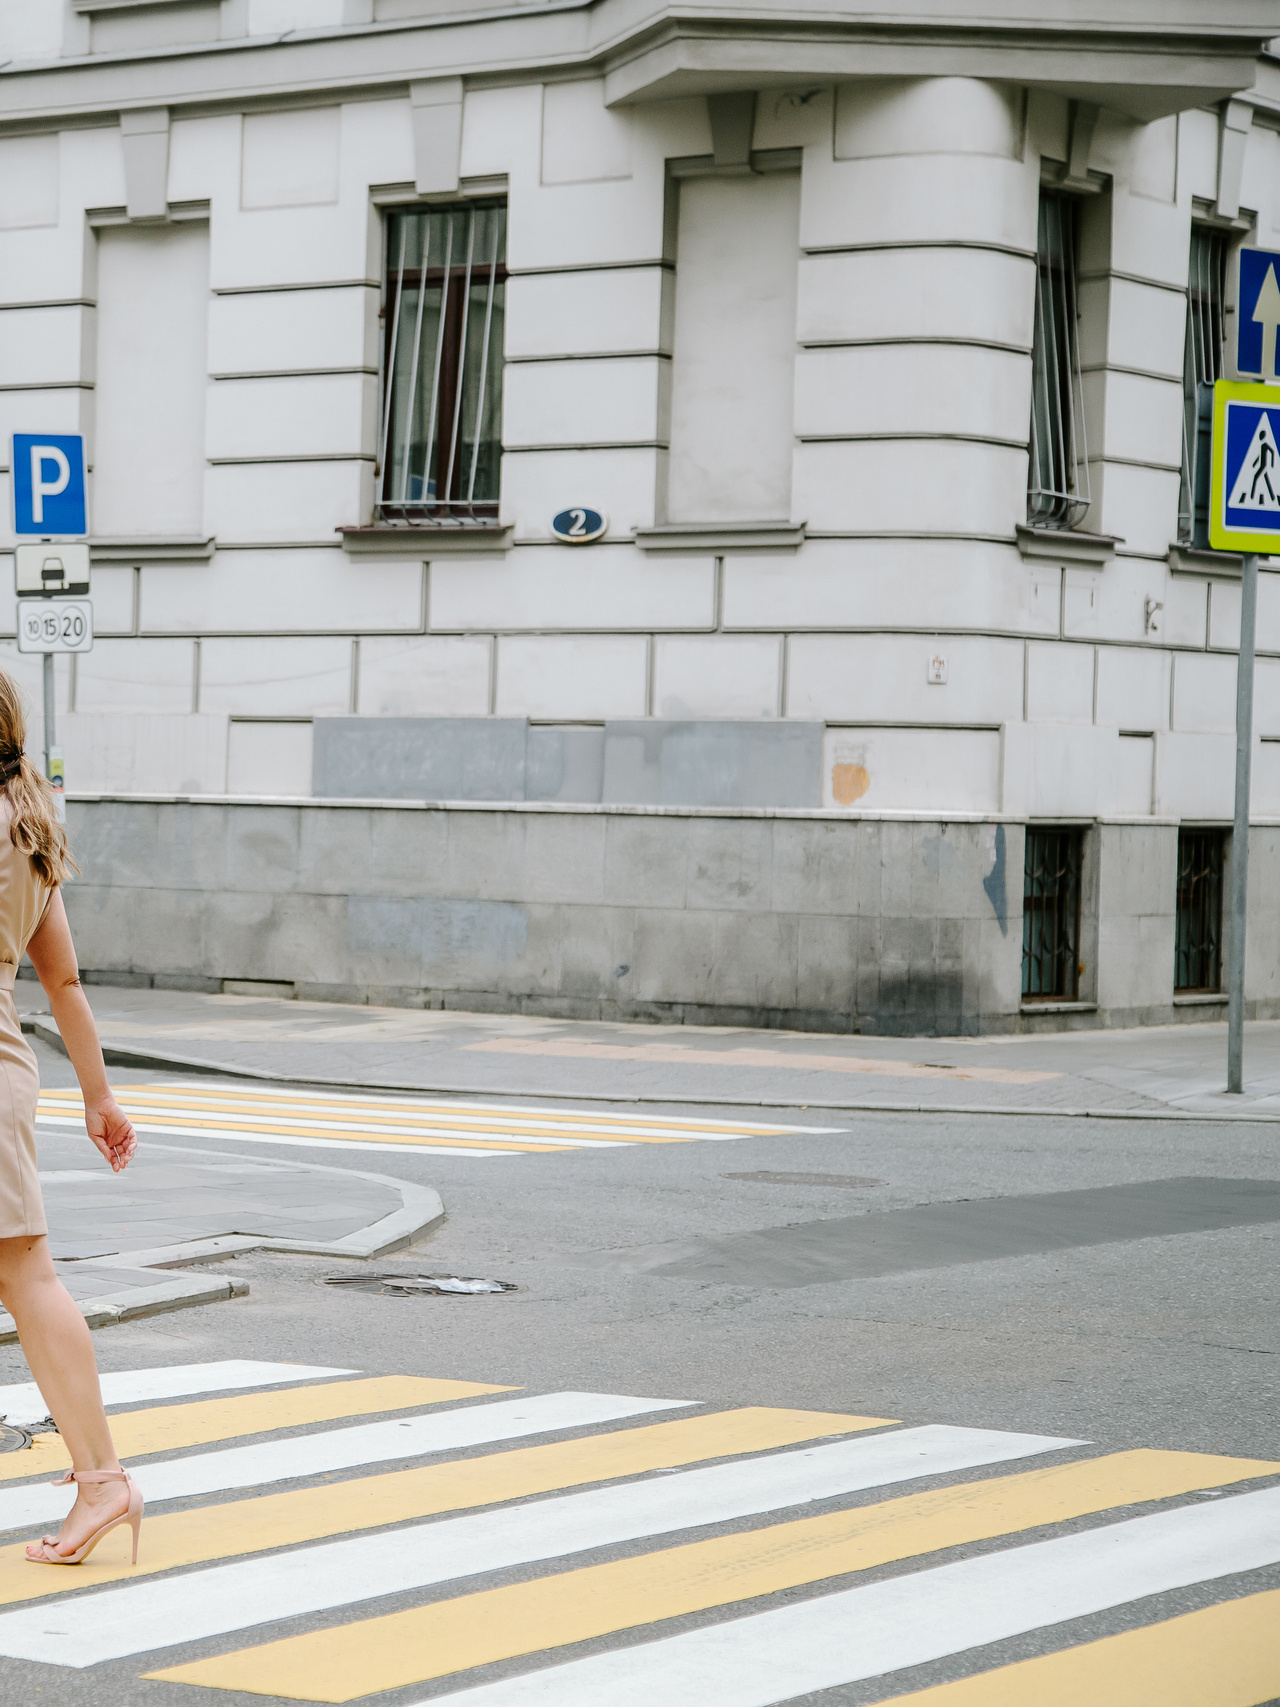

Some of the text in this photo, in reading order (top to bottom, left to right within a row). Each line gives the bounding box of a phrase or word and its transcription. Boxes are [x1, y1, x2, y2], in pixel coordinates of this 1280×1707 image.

[30, 445, 71, 523] P
[568, 509, 587, 536] 2
[28, 617, 83, 637] 10 15 20
